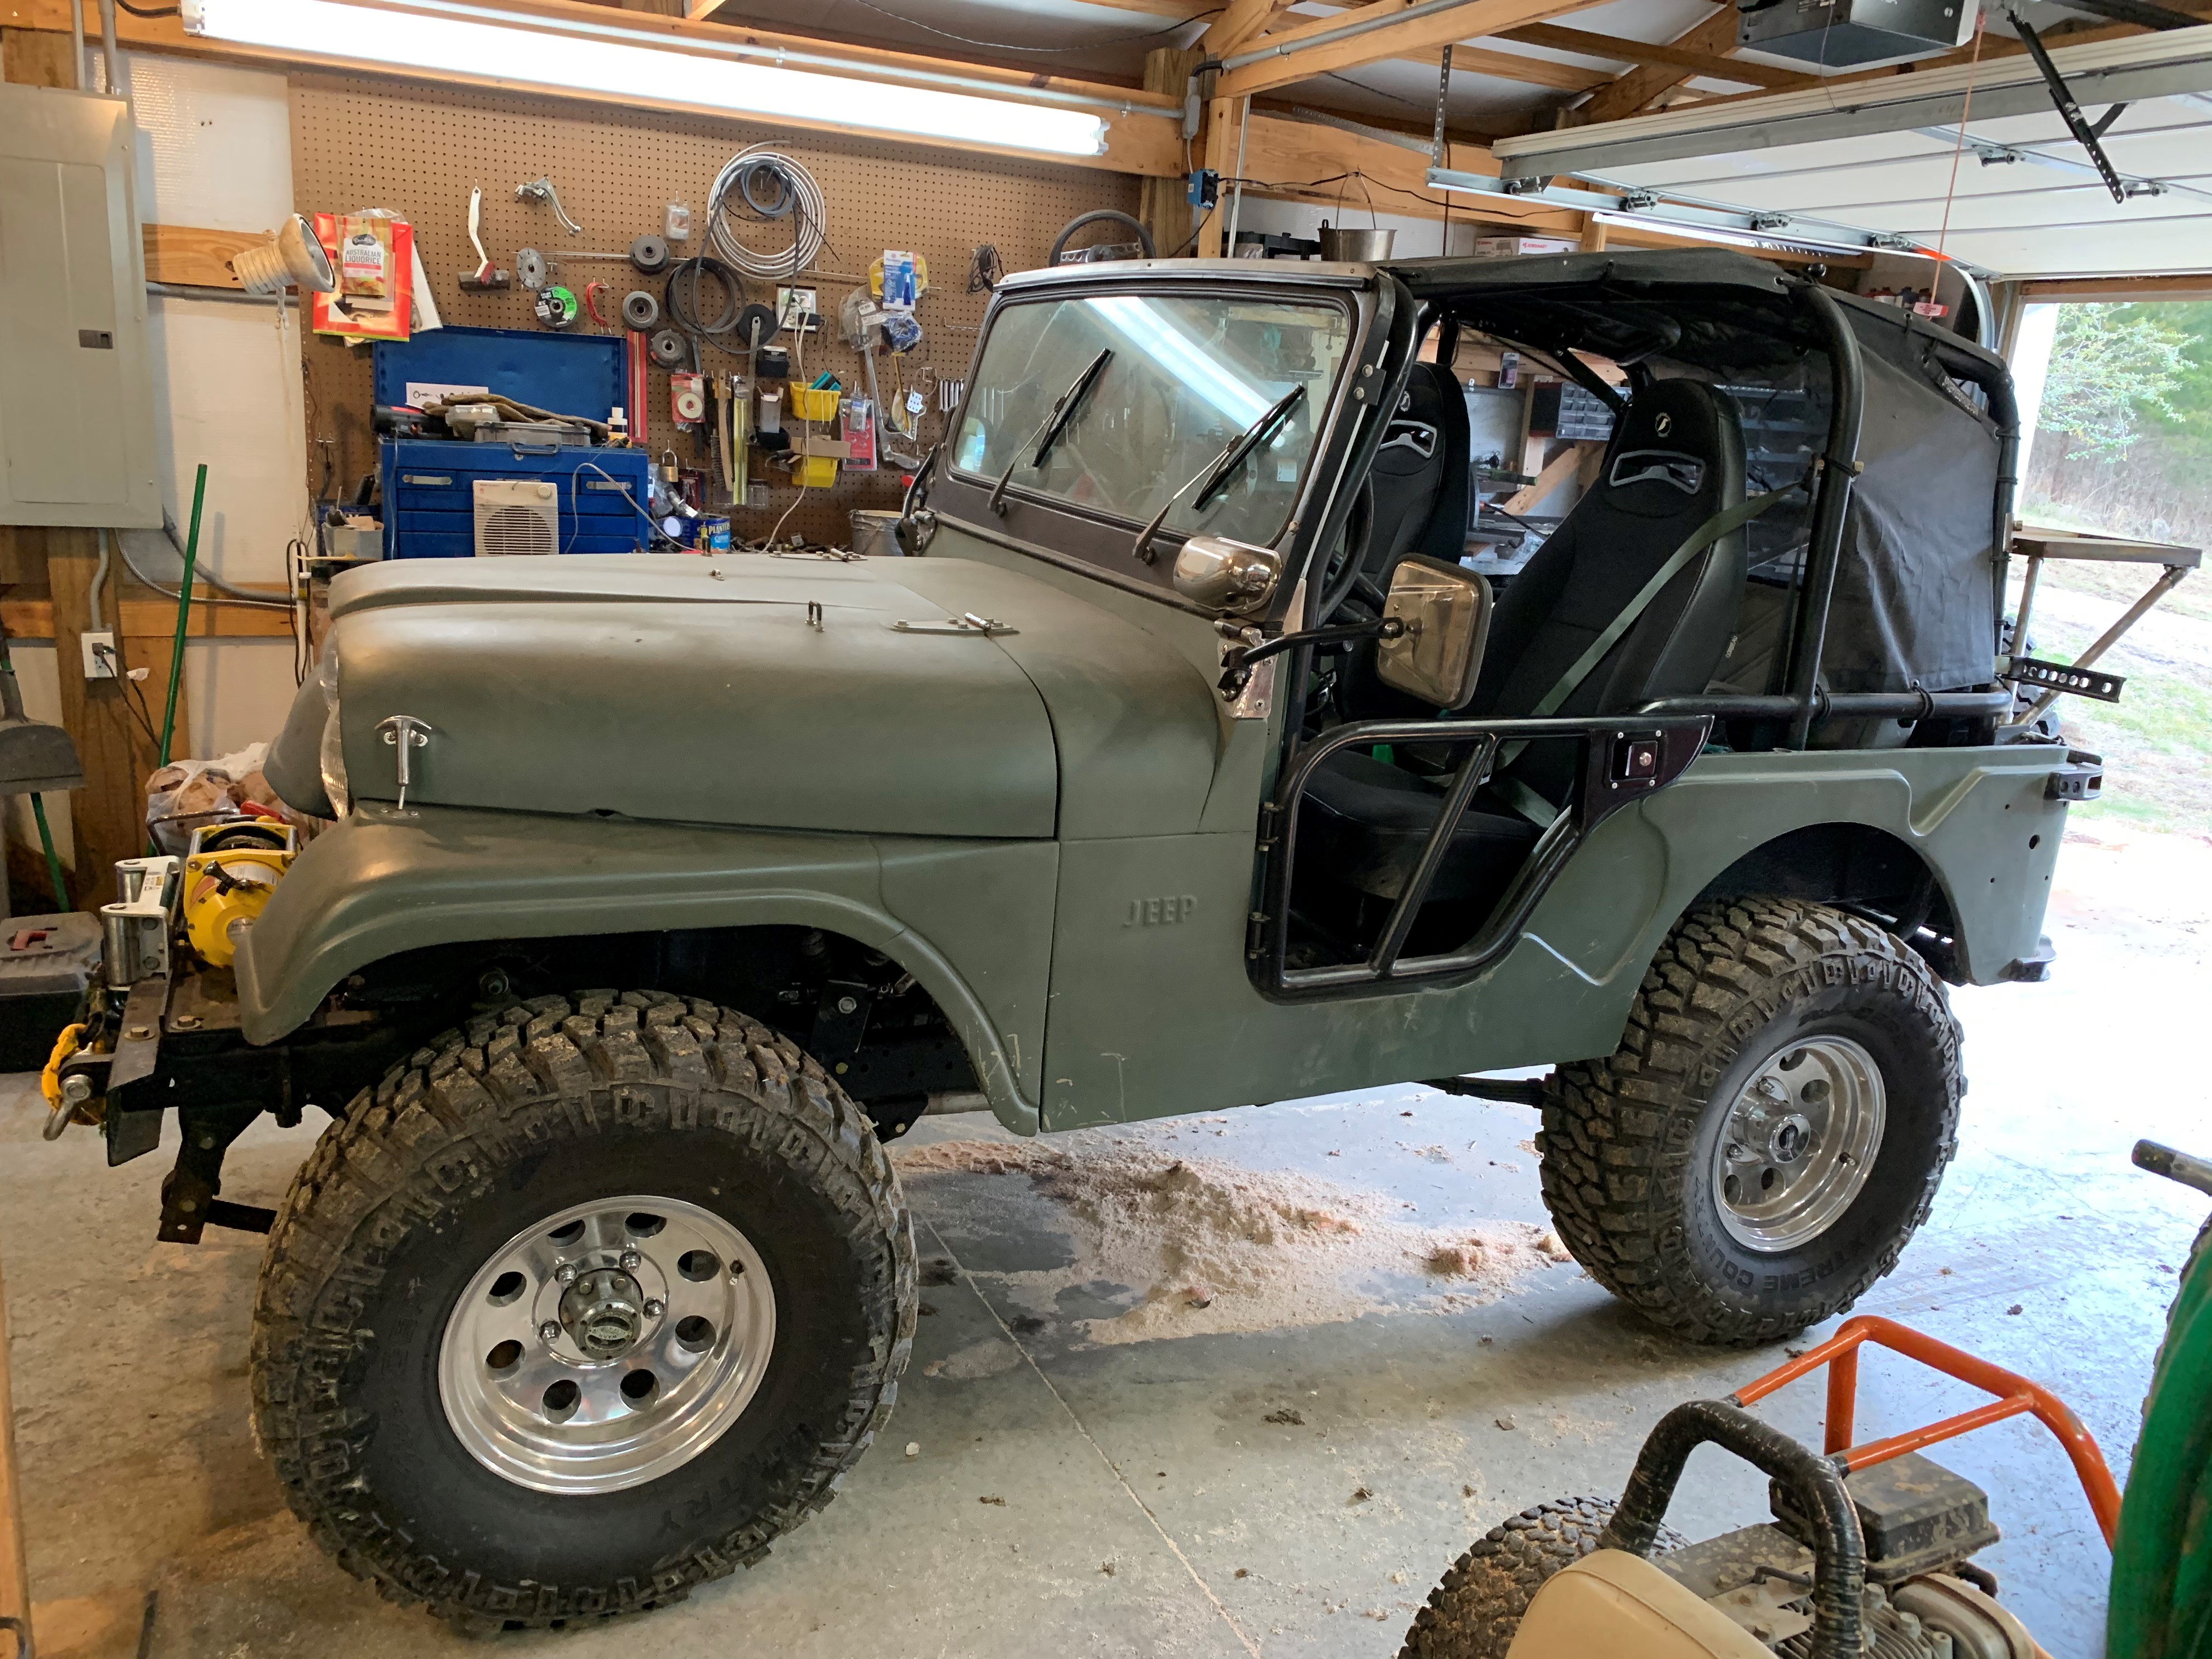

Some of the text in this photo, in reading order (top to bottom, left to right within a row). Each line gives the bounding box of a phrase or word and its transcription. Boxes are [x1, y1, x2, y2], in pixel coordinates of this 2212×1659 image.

[346, 249, 381, 258] AUSTRALIAN
[345, 256, 381, 264] LIQUORICE
[1122, 894, 1198, 928] JEEP
